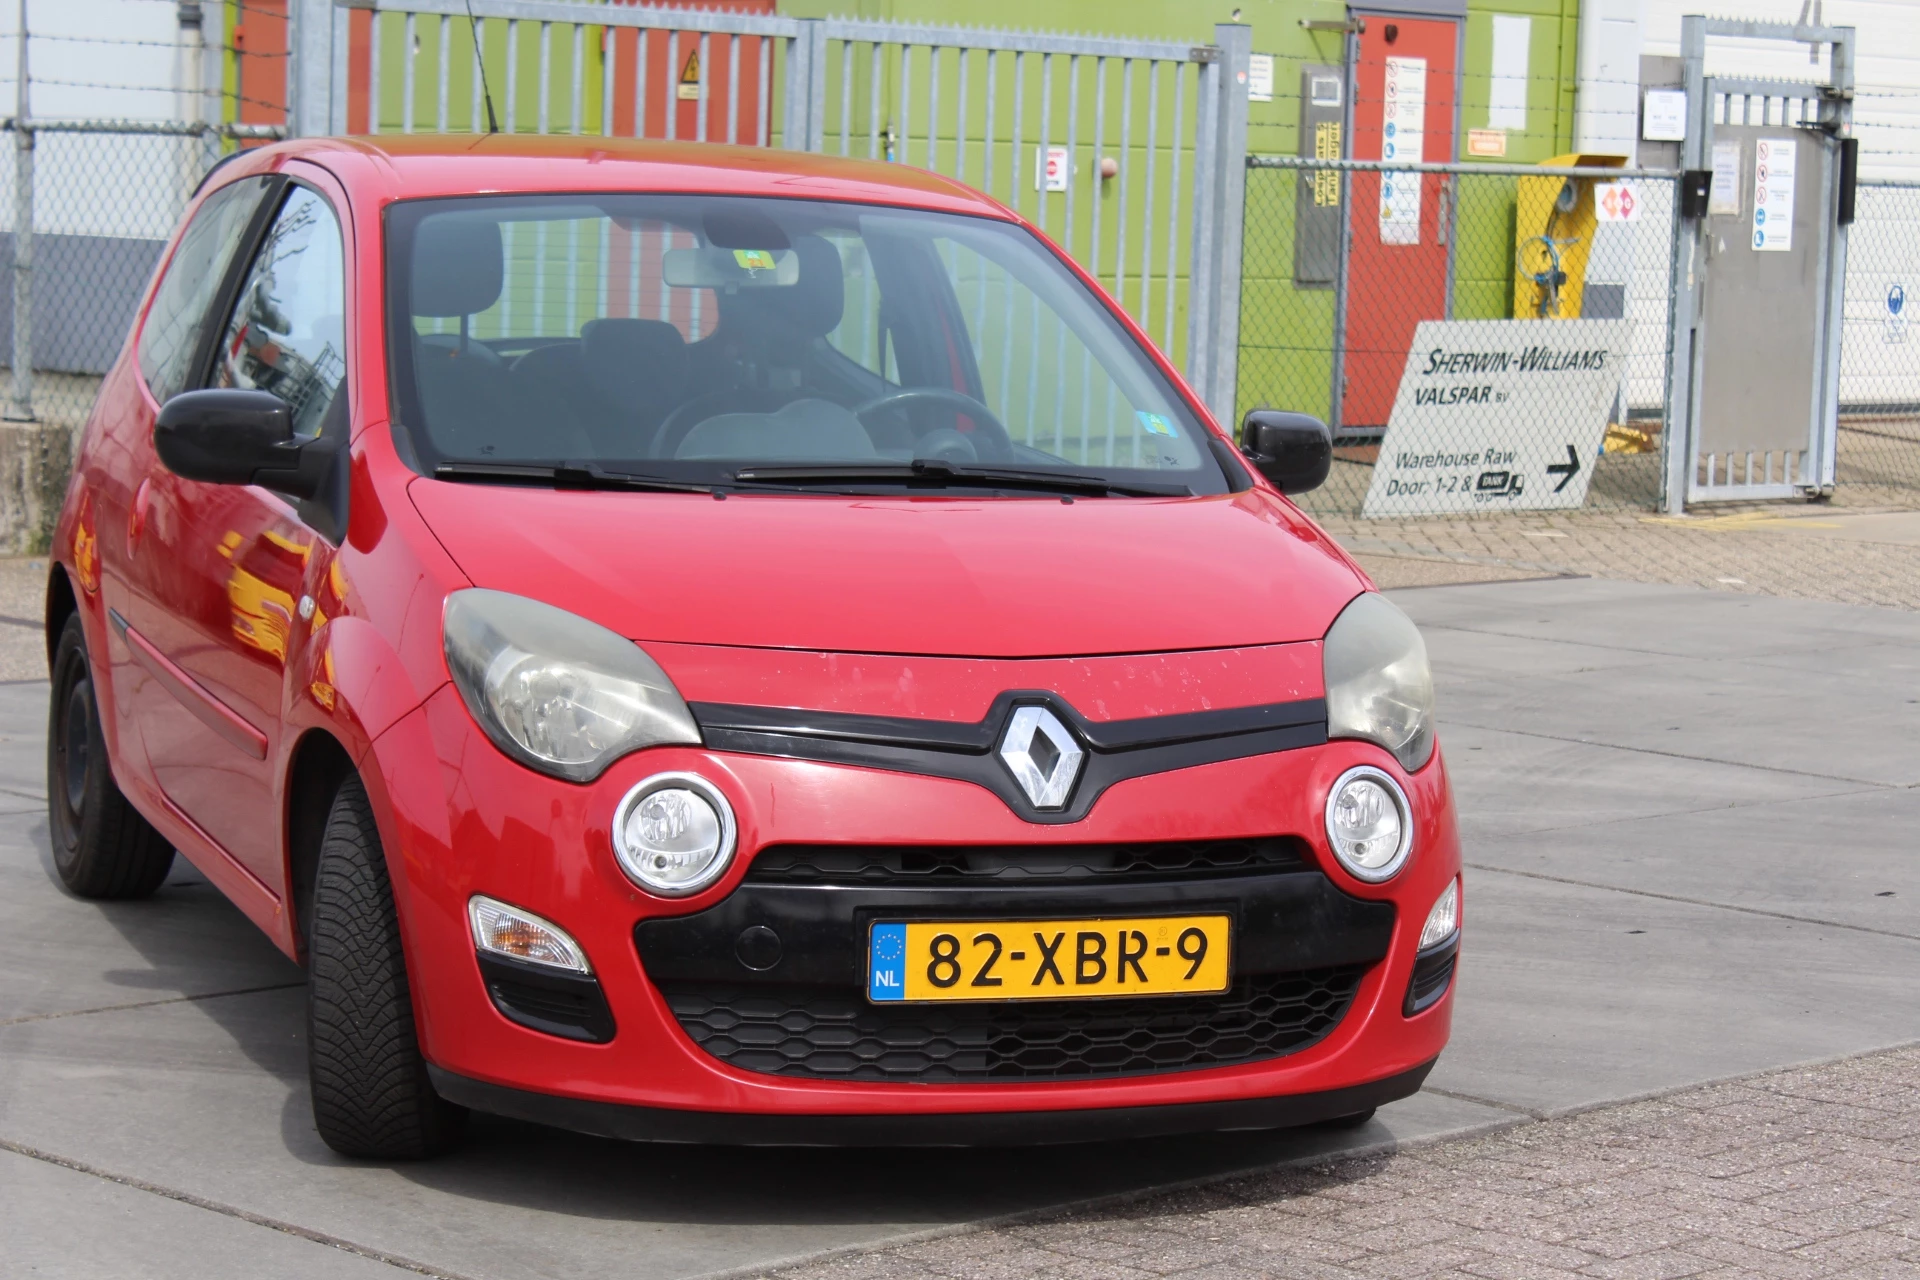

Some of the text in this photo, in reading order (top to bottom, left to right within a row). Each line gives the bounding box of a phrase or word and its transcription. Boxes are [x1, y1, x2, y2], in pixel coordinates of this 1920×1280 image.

[1316, 136, 1327, 205] Lospats
[1328, 121, 1340, 203] Tankagen
[1415, 386, 1492, 406] VALSPAR
[1396, 448, 1517, 470] Warehouse Raw
[1436, 476, 1458, 494] 1-2
[1461, 475, 1473, 493] &
[1482, 475, 1505, 488] TANK
[875, 926, 1209, 989] NL 82-XBR-9
